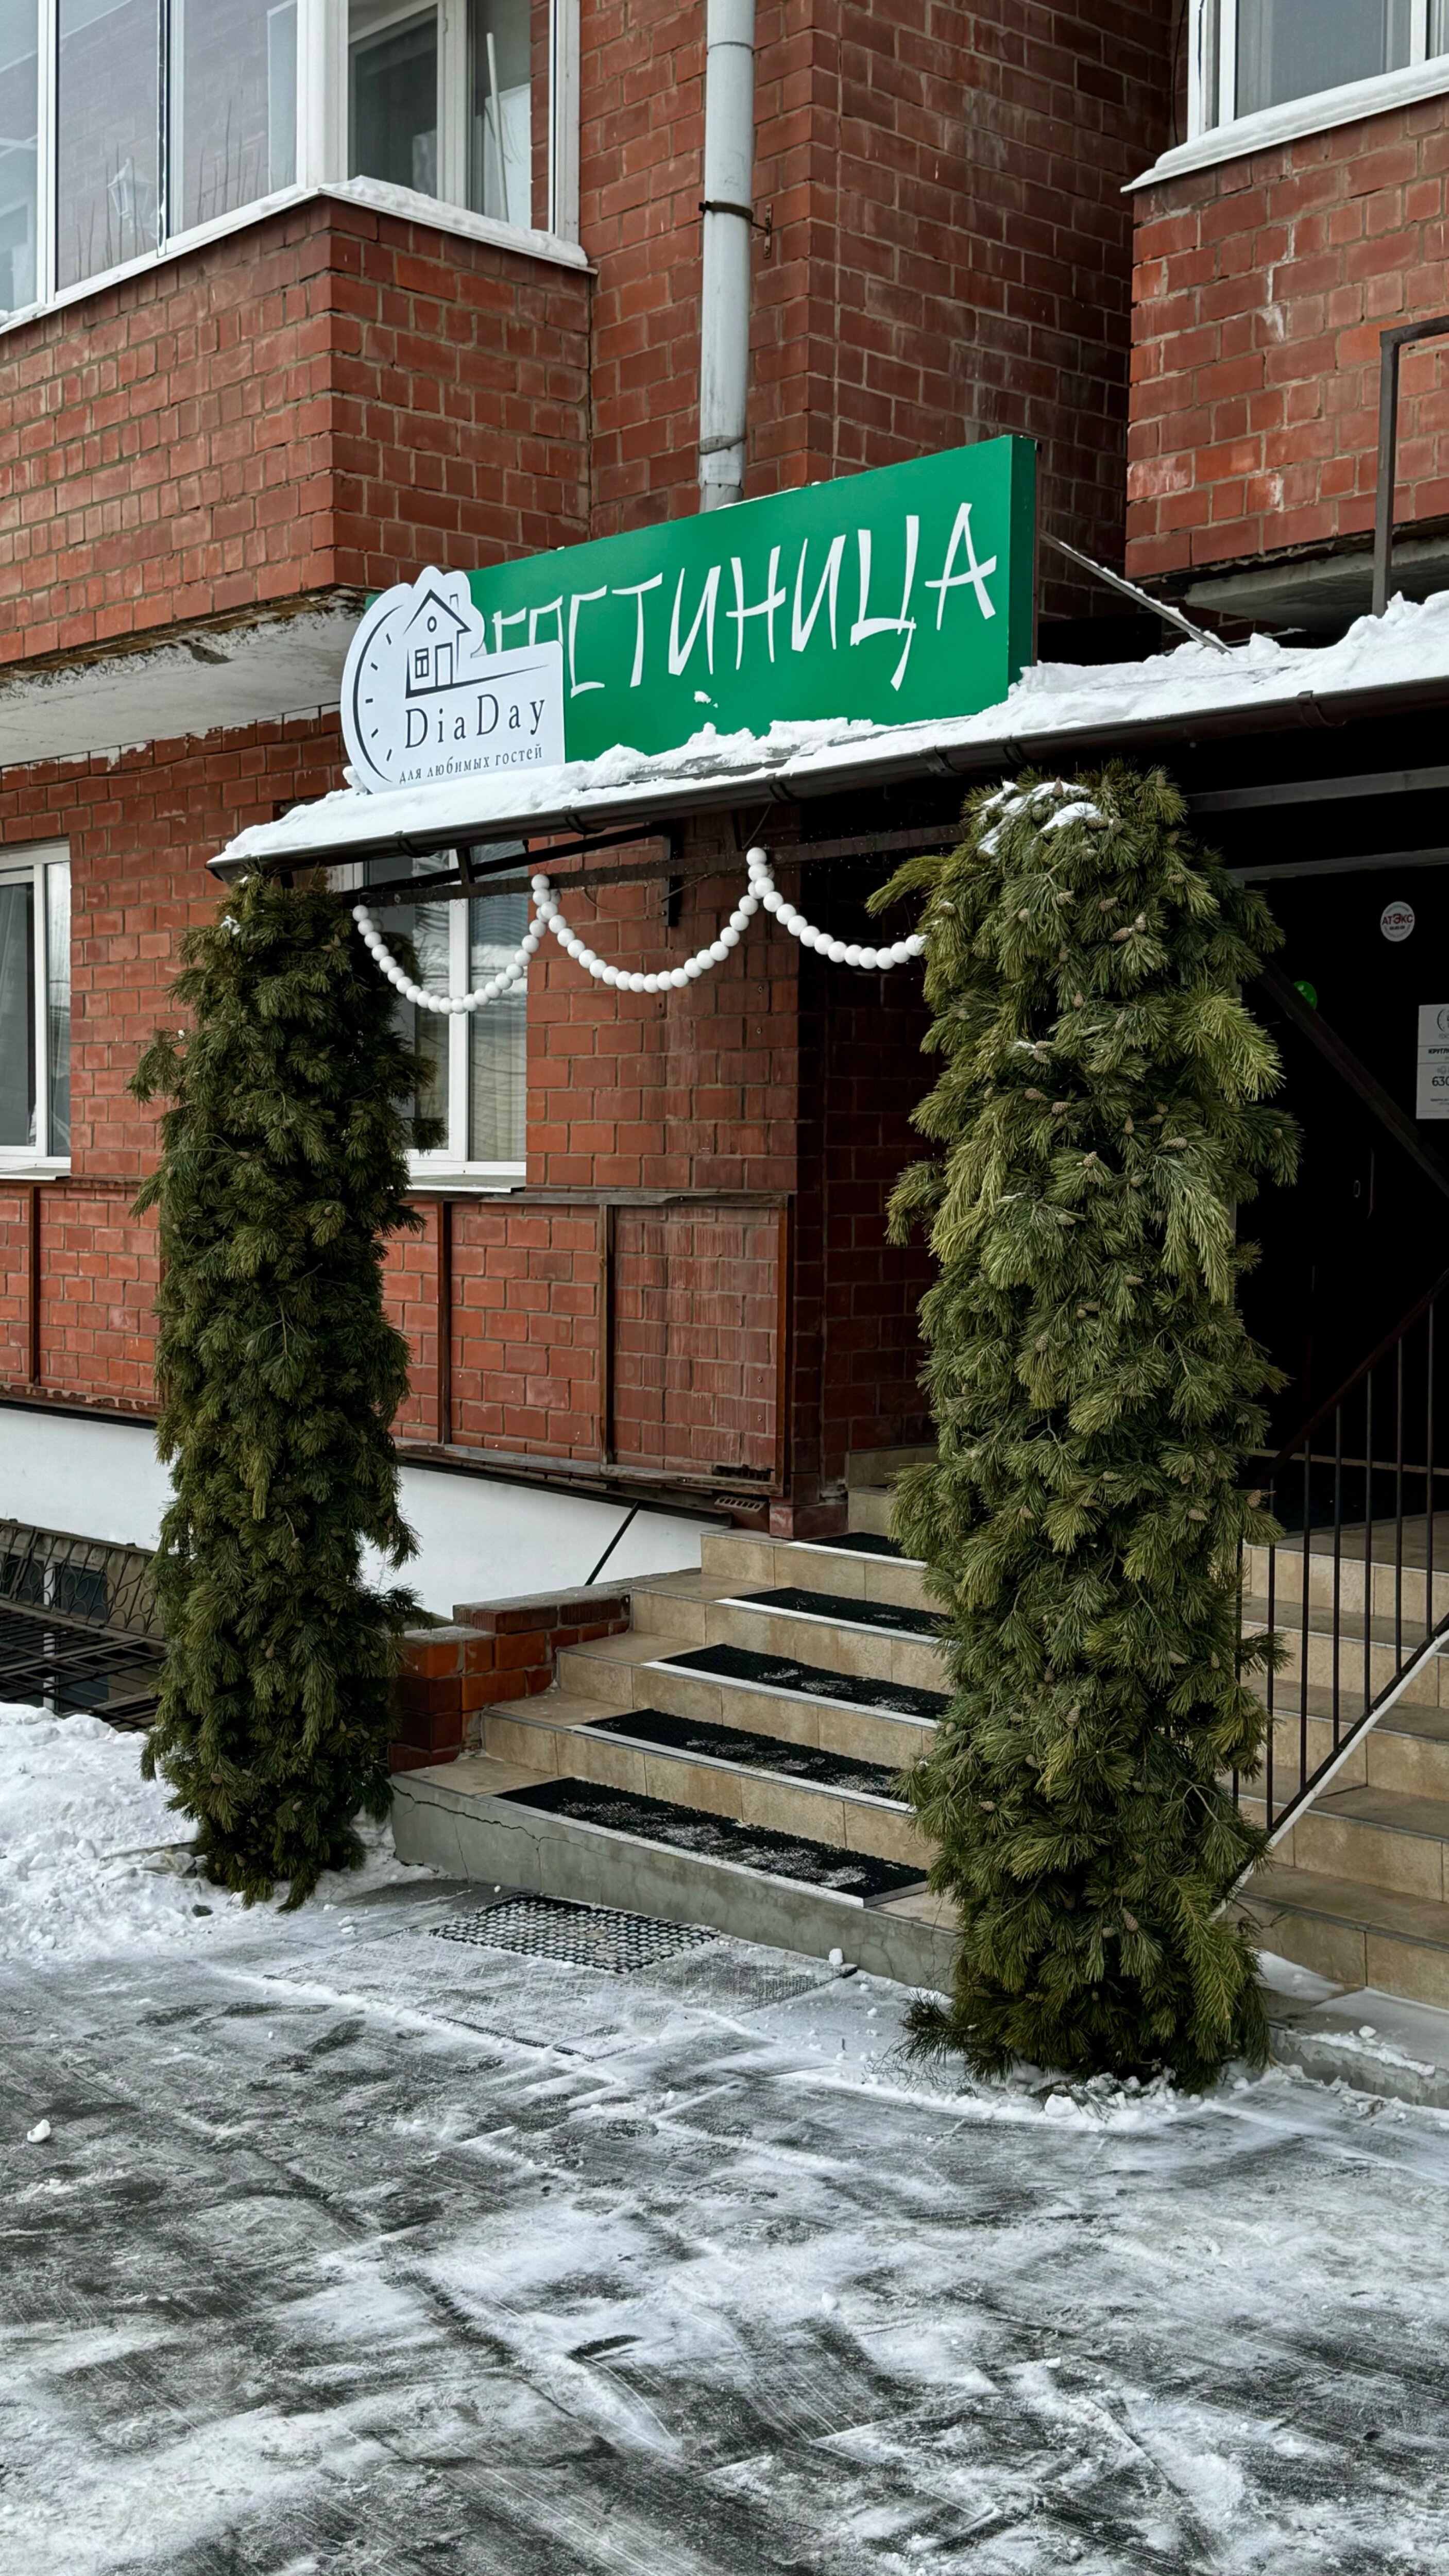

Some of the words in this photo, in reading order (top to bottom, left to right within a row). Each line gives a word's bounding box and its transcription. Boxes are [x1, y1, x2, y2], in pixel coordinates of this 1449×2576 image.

[405, 693, 545, 749] DiaDay
[427, 756, 490, 777] любимых
[496, 743, 542, 766] гостей
[1382, 913, 1413, 925] АТЭКС
